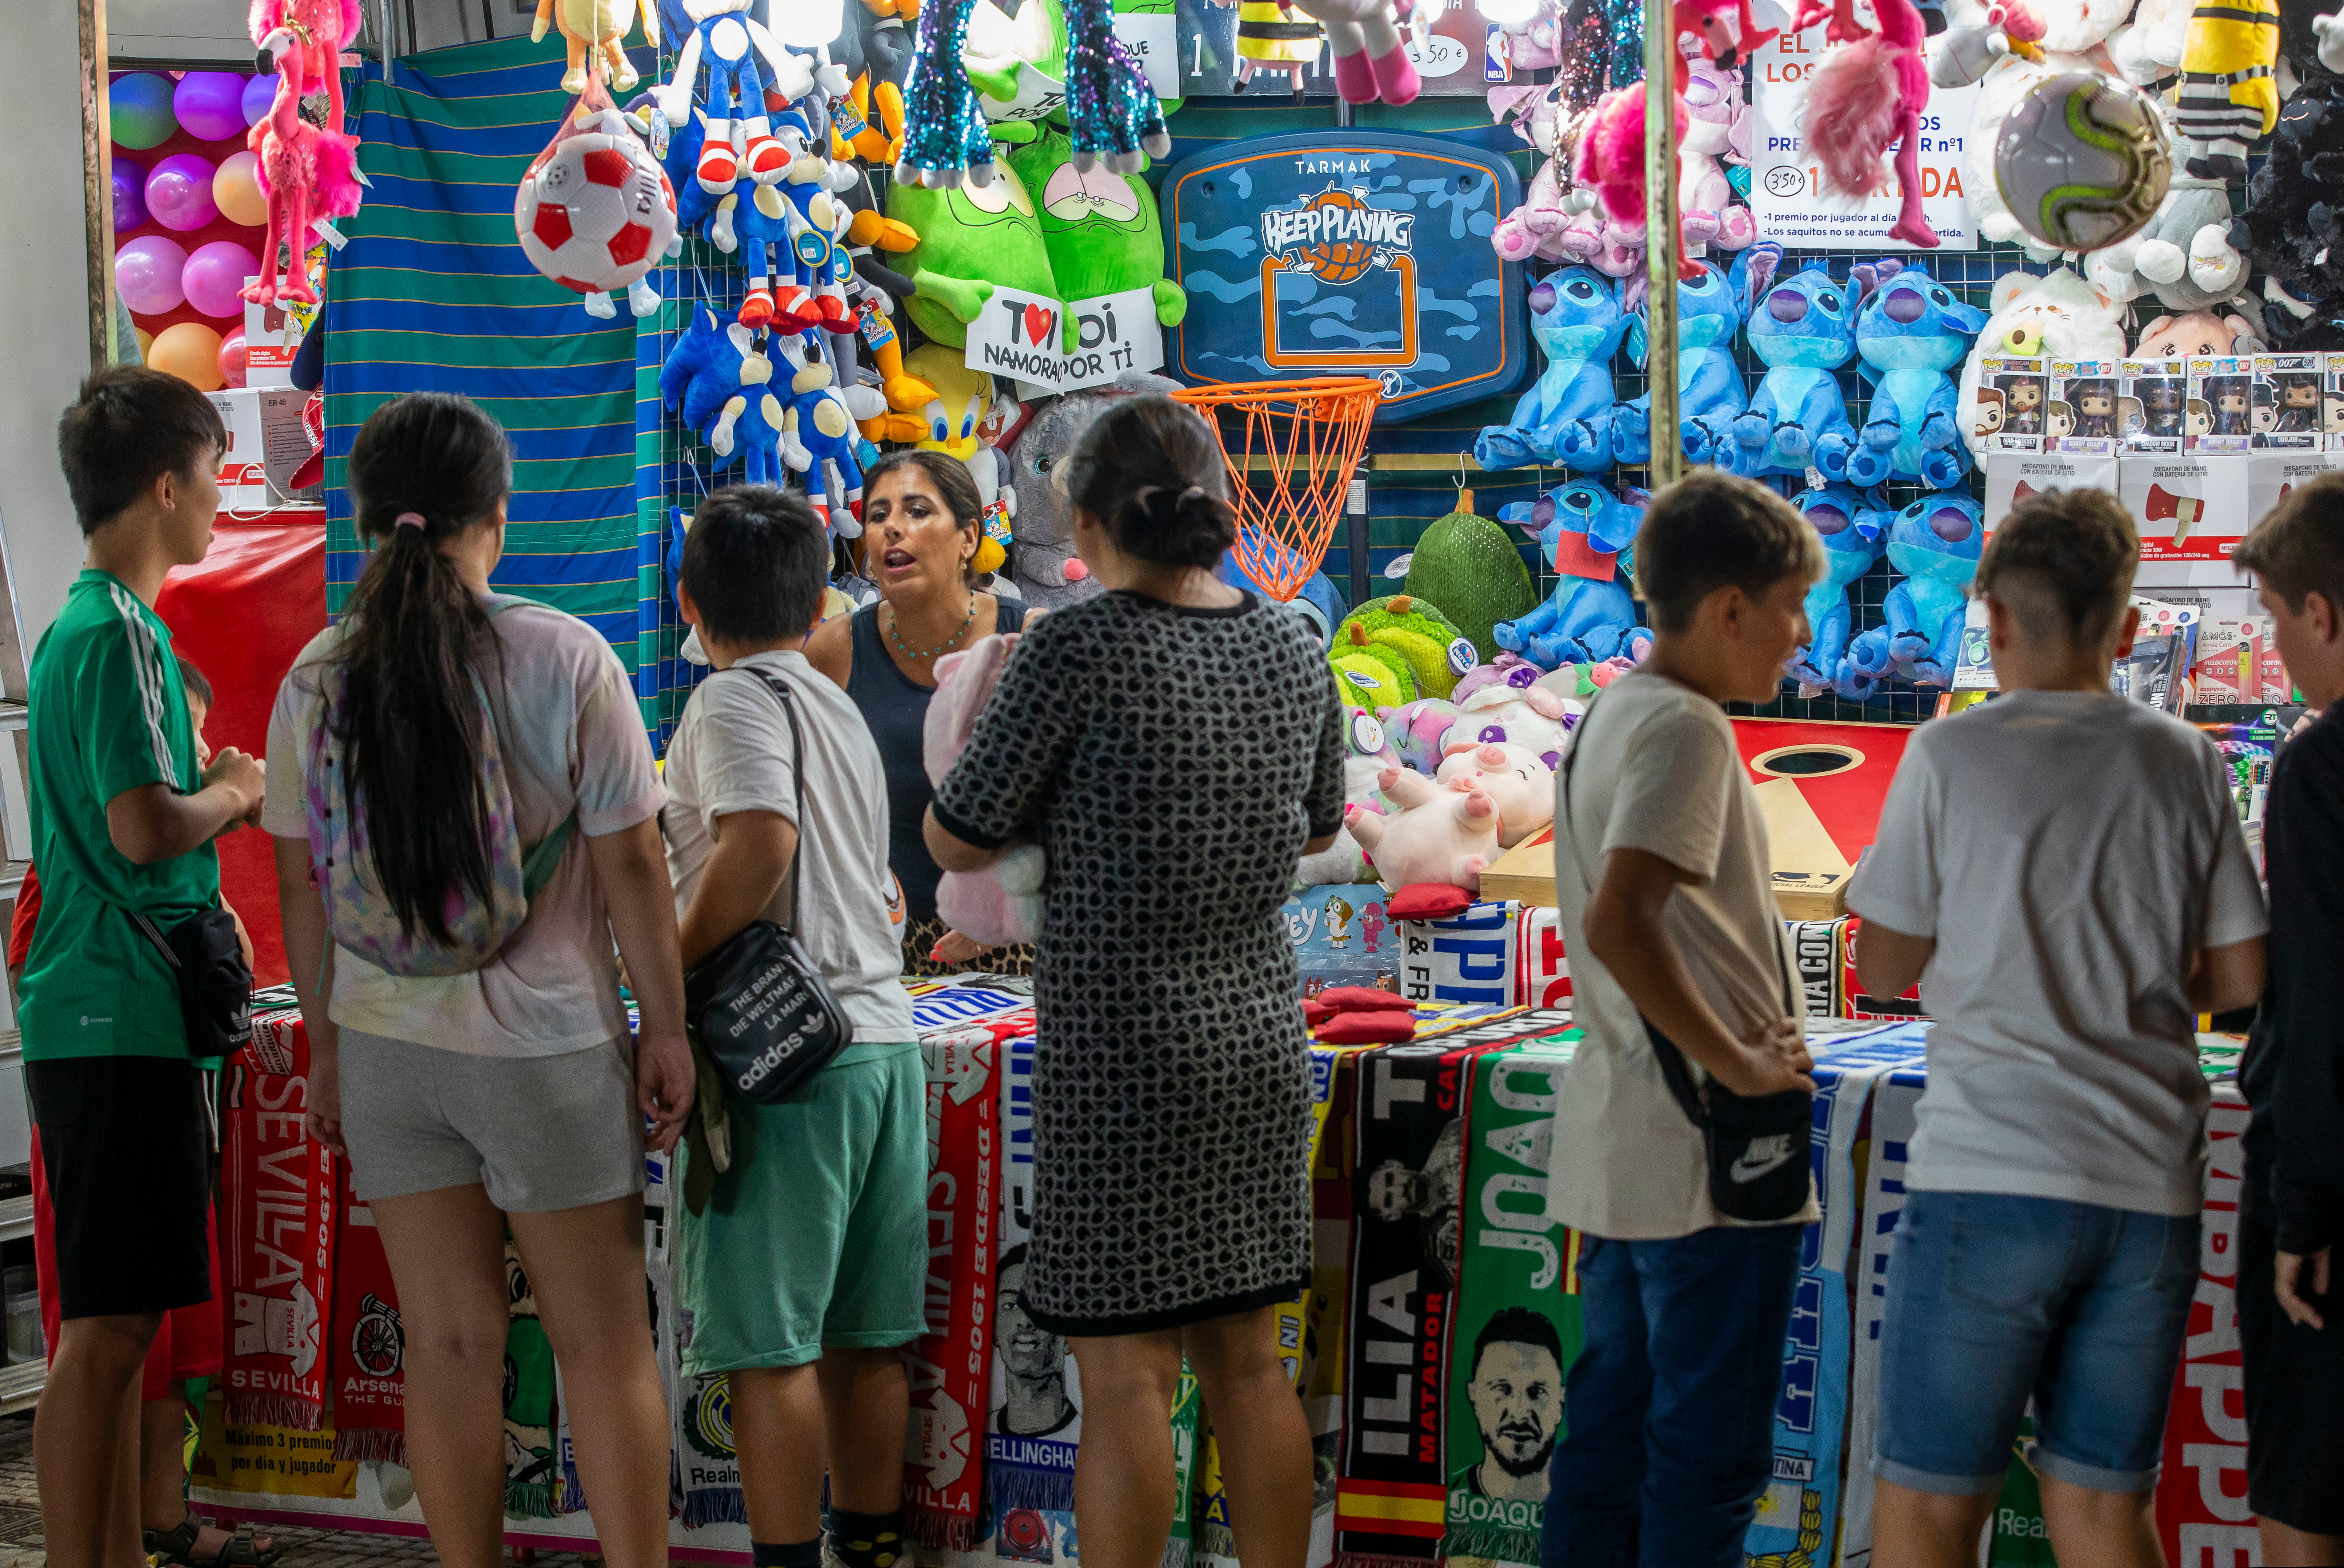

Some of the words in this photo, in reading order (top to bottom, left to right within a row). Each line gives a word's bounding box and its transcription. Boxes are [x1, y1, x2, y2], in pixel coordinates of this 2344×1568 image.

[1780, 34, 1810, 53] EL
[1487, 70, 1503, 79] NBA
[1006, 108, 1047, 118] POR
[840, 115, 858, 131] LOONEY
[844, 121, 859, 133] TUNES
[1295, 159, 1370, 174] TARMAK
[1775, 213, 1808, 224] premio
[1811, 215, 1827, 224] por
[1831, 213, 1868, 224] jugador
[1870, 213, 1879, 222] al
[1882, 213, 1897, 222] día
[1264, 210, 1322, 255] KEEP
[1322, 204, 1412, 245] PLAYING
[1764, 227, 1784, 236] -Los
[1787, 227, 1827, 238] saquitos
[1933, 229, 1964, 237] artida.
[868, 324, 886, 340] LOONEY
[872, 330, 887, 342] TUNES
[1982, 359, 2004, 370] POP!
[2053, 363, 2074, 374] POP!
[2122, 363, 2143, 374] POP!
[2190, 361, 2213, 372] POP!
[2254, 357, 2277, 369] POP!
[2278, 358, 2301, 368] 007
[2303, 358, 2314, 366] 520
[990, 527, 1008, 538] LOONEY
[993, 532, 1007, 541] TUNES
[1452, 646, 1471, 670] MOYA
[2149, 692, 2165, 710] UN
[729, 989, 754, 1013] THE
[729, 1016, 750, 1038] DIE
[764, 1014, 783, 1030] LA
[738, 1032, 804, 1091] adidas
[1744, 1134, 1792, 1161] NIKE
[255, 1074, 308, 1289] SEVILLA
[974, 1126, 990, 1274] DESDE
[317, 1182, 330, 1270] 1905
[287, 1307, 296, 1349] SEVILLA
[968, 1282, 985, 1375] 1905
[1362, 1269, 1418, 1456] ILIA
[231, 1370, 320, 1399] SEVILLA
[1418, 1293, 1444, 1464] MATADOR
[344, 1394, 376, 1404] THE
[225, 1429, 274, 1448] Máximo
[277, 1433, 286, 1447] 3
[231, 1457, 252, 1471] por
[255, 1454, 275, 1470] día
[278, 1460, 286, 1474] y
[289, 1460, 337, 1475] jugador
[1998, 1507, 2047, 1539] Rea
